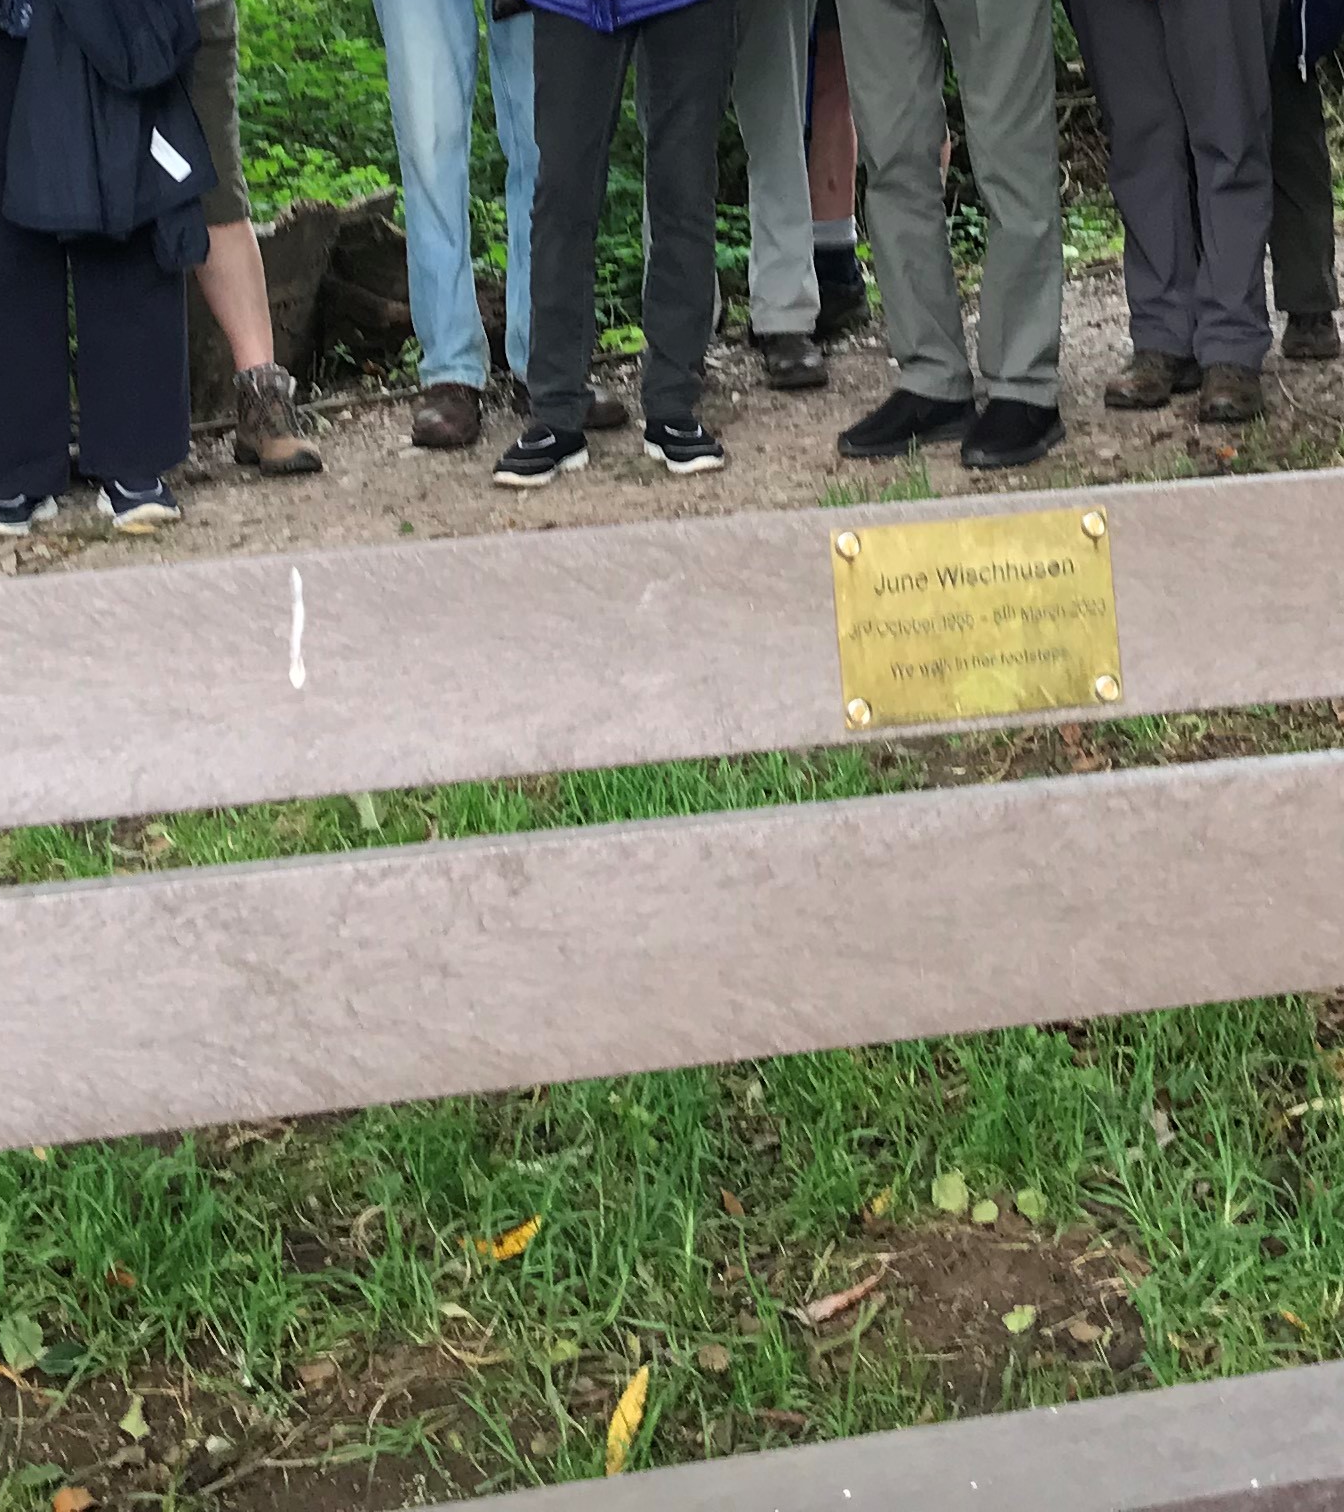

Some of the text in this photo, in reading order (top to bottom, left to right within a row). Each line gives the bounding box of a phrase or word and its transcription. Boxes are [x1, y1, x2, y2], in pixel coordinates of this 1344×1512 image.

[873, 556, 1076, 596] June Wischhusen
[1020, 602, 1066, 623] March
[890, 662, 914, 681] We
[955, 656, 969, 672] in
[972, 653, 995, 669] her
